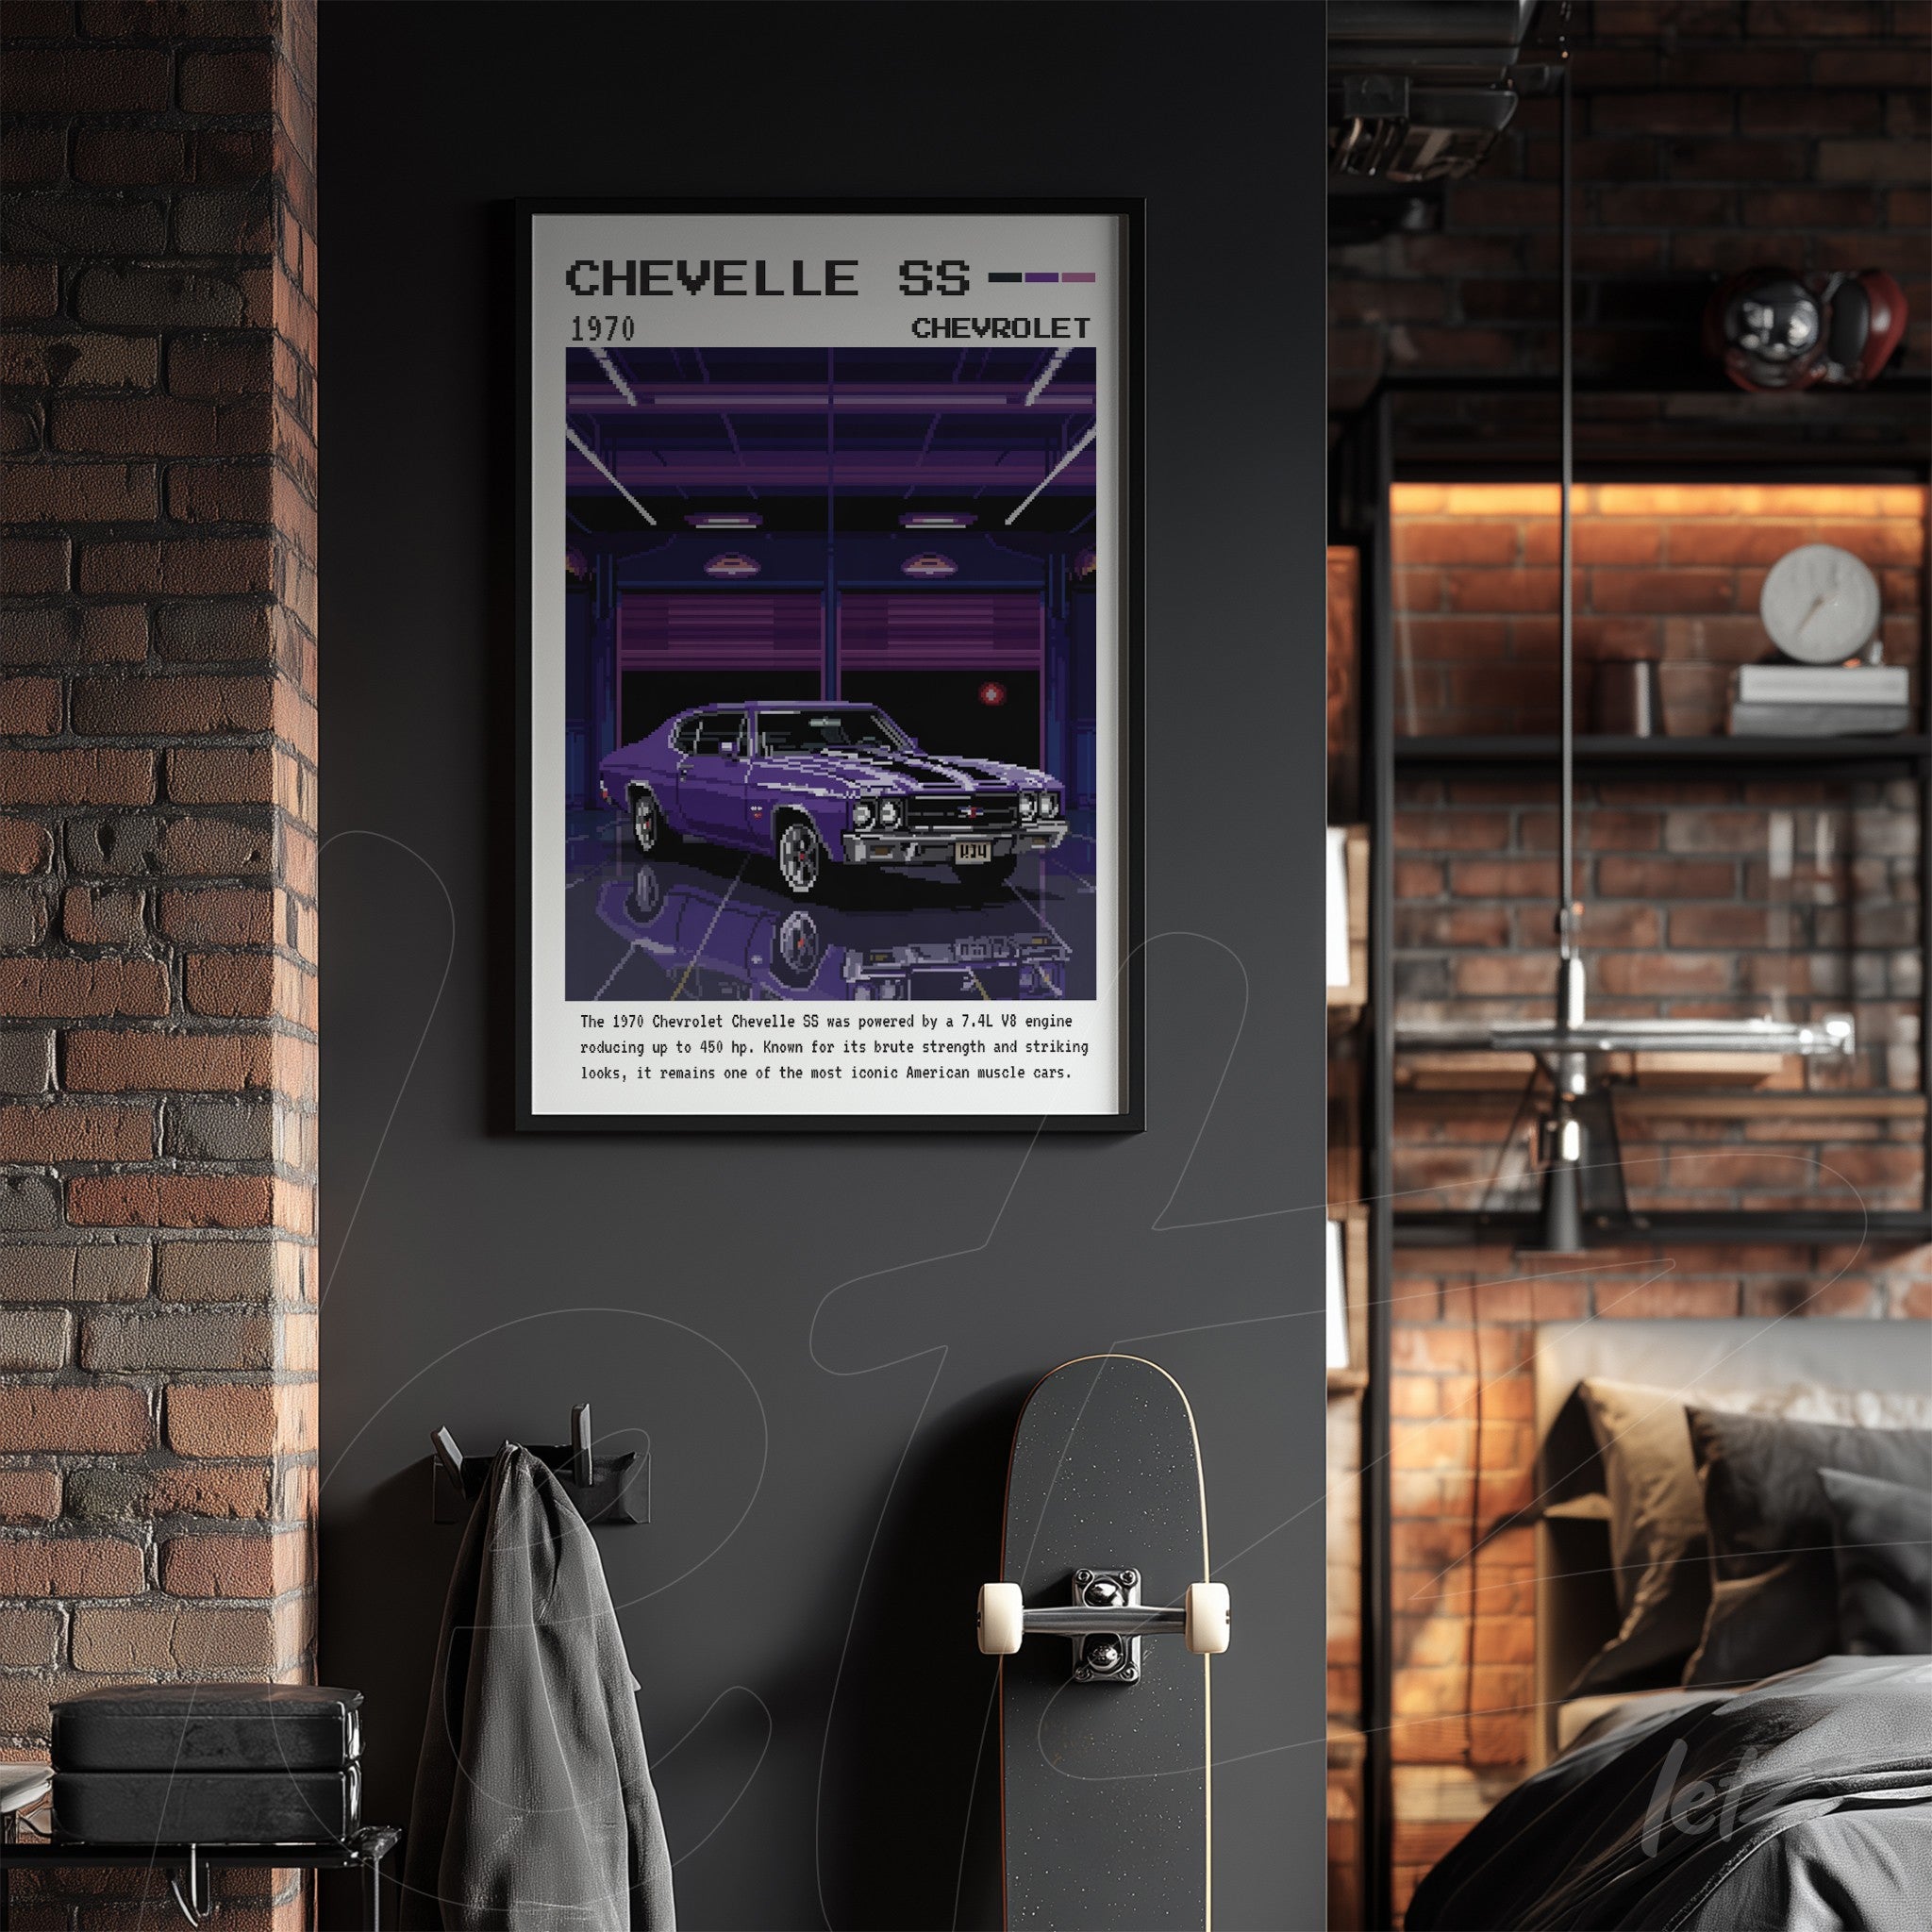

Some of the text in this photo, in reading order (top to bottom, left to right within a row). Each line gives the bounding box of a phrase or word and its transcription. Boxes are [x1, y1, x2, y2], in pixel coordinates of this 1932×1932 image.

[566, 260, 970, 295] CHEVELLE SS
[572, 316, 635, 341] 1970
[912, 318, 1091, 339] CHEVROLET
[580, 1013, 1073, 1030] The 1970 Chevrolet Chevelle SS was powered by a 7.4L V8 engine
[580, 1040, 1089, 1058] roducing up to 450 hp. Known for its brute strength and striking
[581, 1065, 1071, 1083] looks, it remains one of the most iconic American muscle cars.
